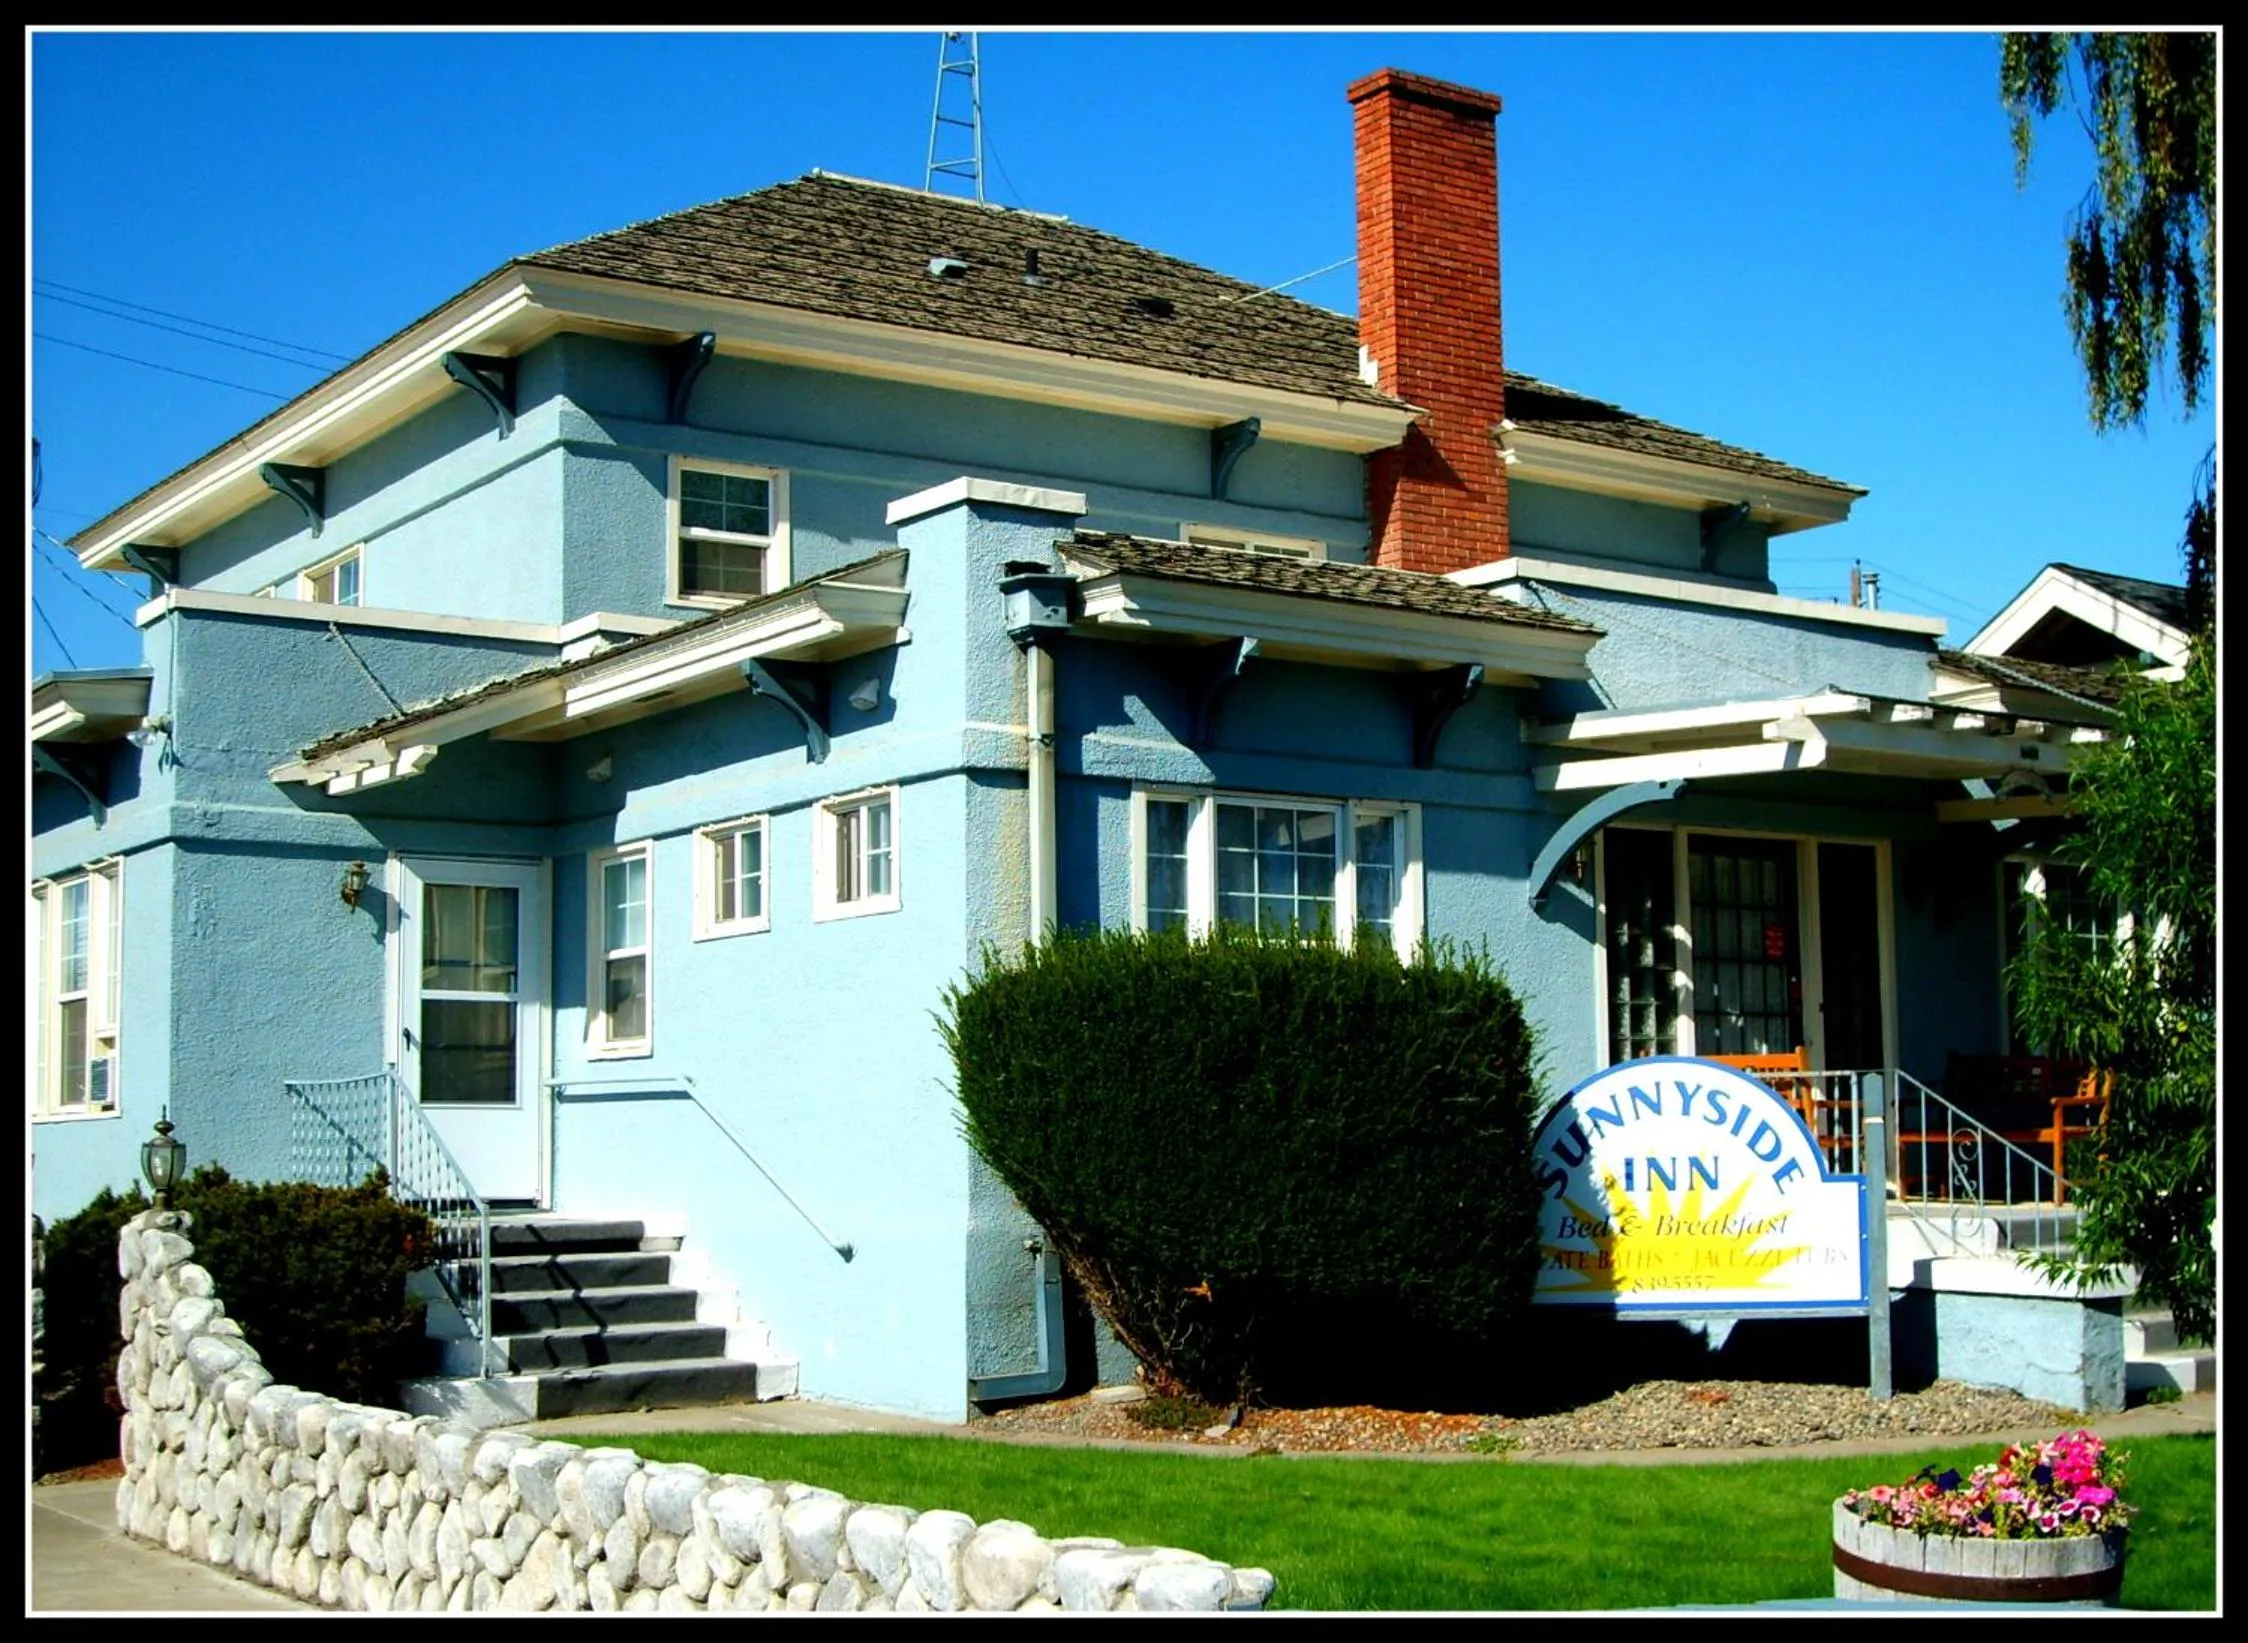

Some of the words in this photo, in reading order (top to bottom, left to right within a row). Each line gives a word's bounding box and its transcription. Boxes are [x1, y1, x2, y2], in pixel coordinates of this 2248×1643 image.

[1537, 1080, 1805, 1200] SUNNYSIDE
[1624, 1155, 1720, 1192] INN
[1557, 1215, 1610, 1239] Bed
[1617, 1214, 1641, 1238] &
[1655, 1213, 1789, 1247] Breakfast
